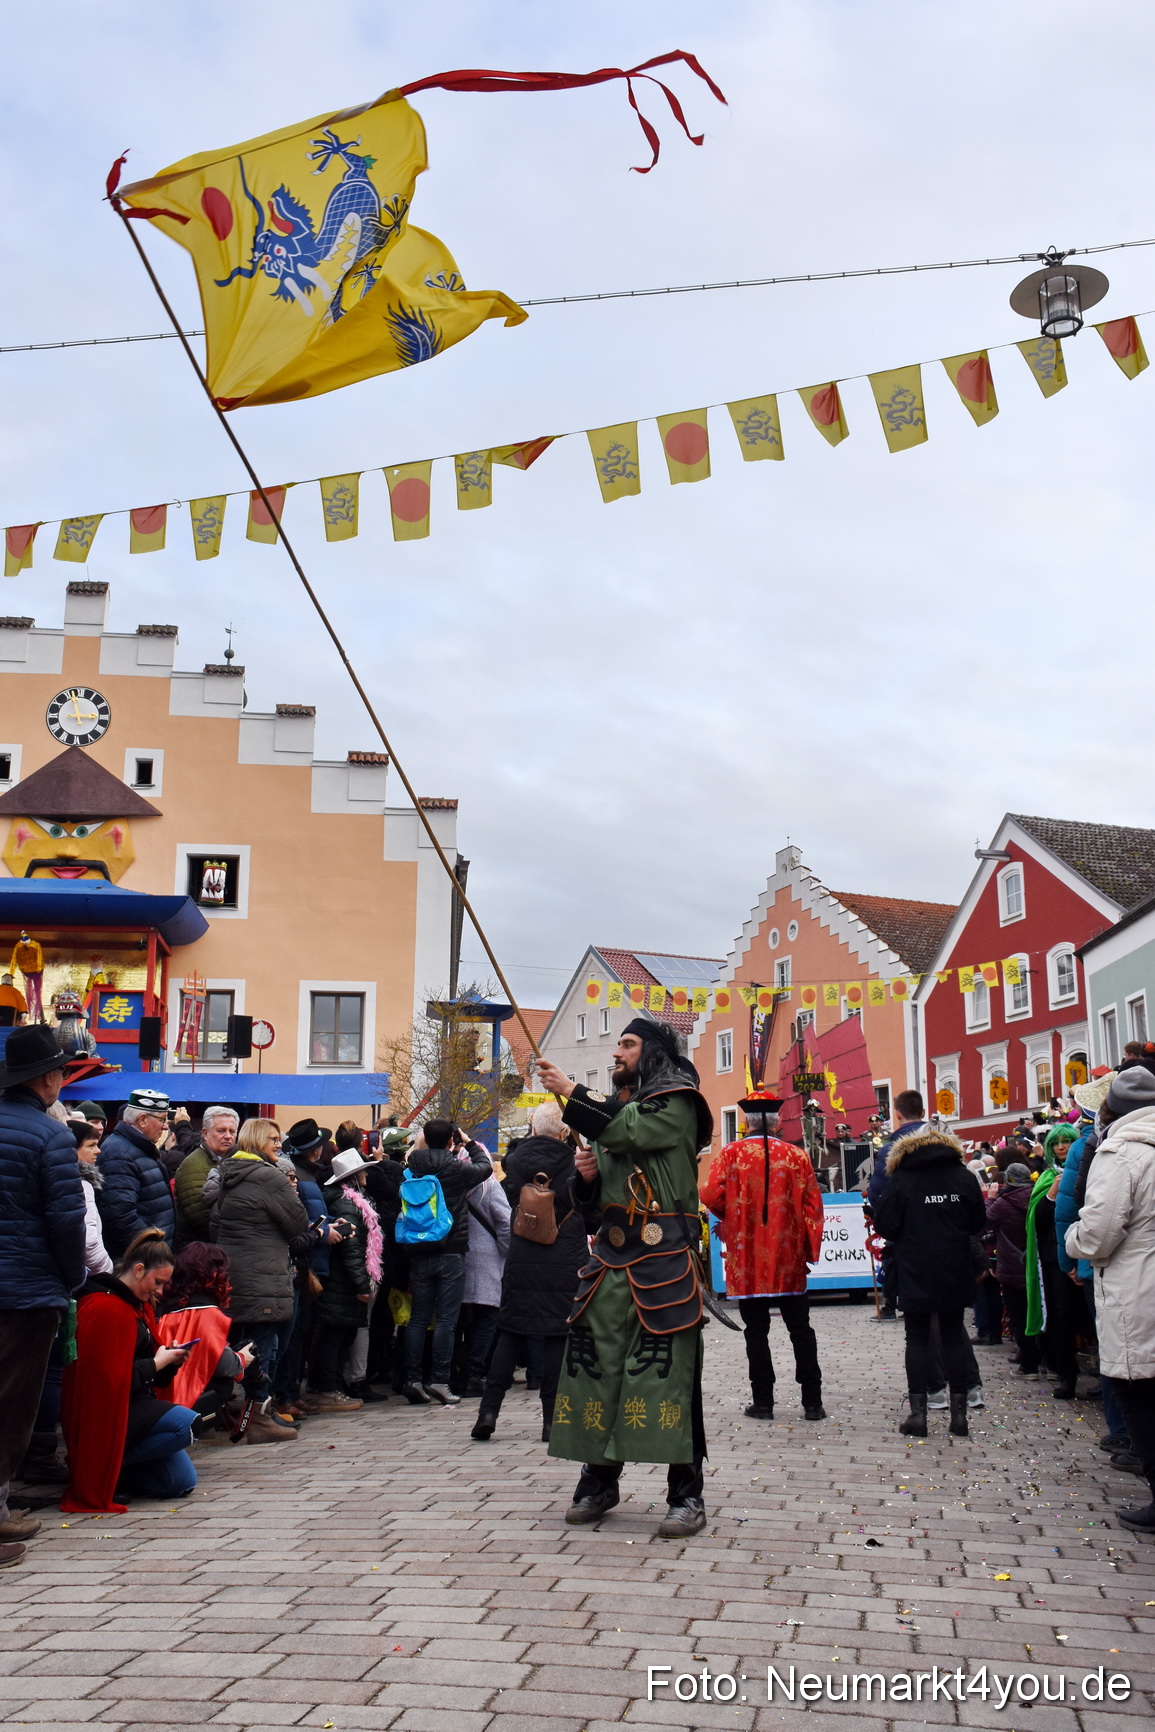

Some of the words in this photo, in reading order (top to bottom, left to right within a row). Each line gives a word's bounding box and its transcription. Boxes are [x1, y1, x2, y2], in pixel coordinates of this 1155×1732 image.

[794, 1074, 824, 1082] KAISER
[798, 1082, 823, 1093] 2020
[824, 1215, 842, 1223] PPE
[824, 1248, 866, 1262] CHINA
